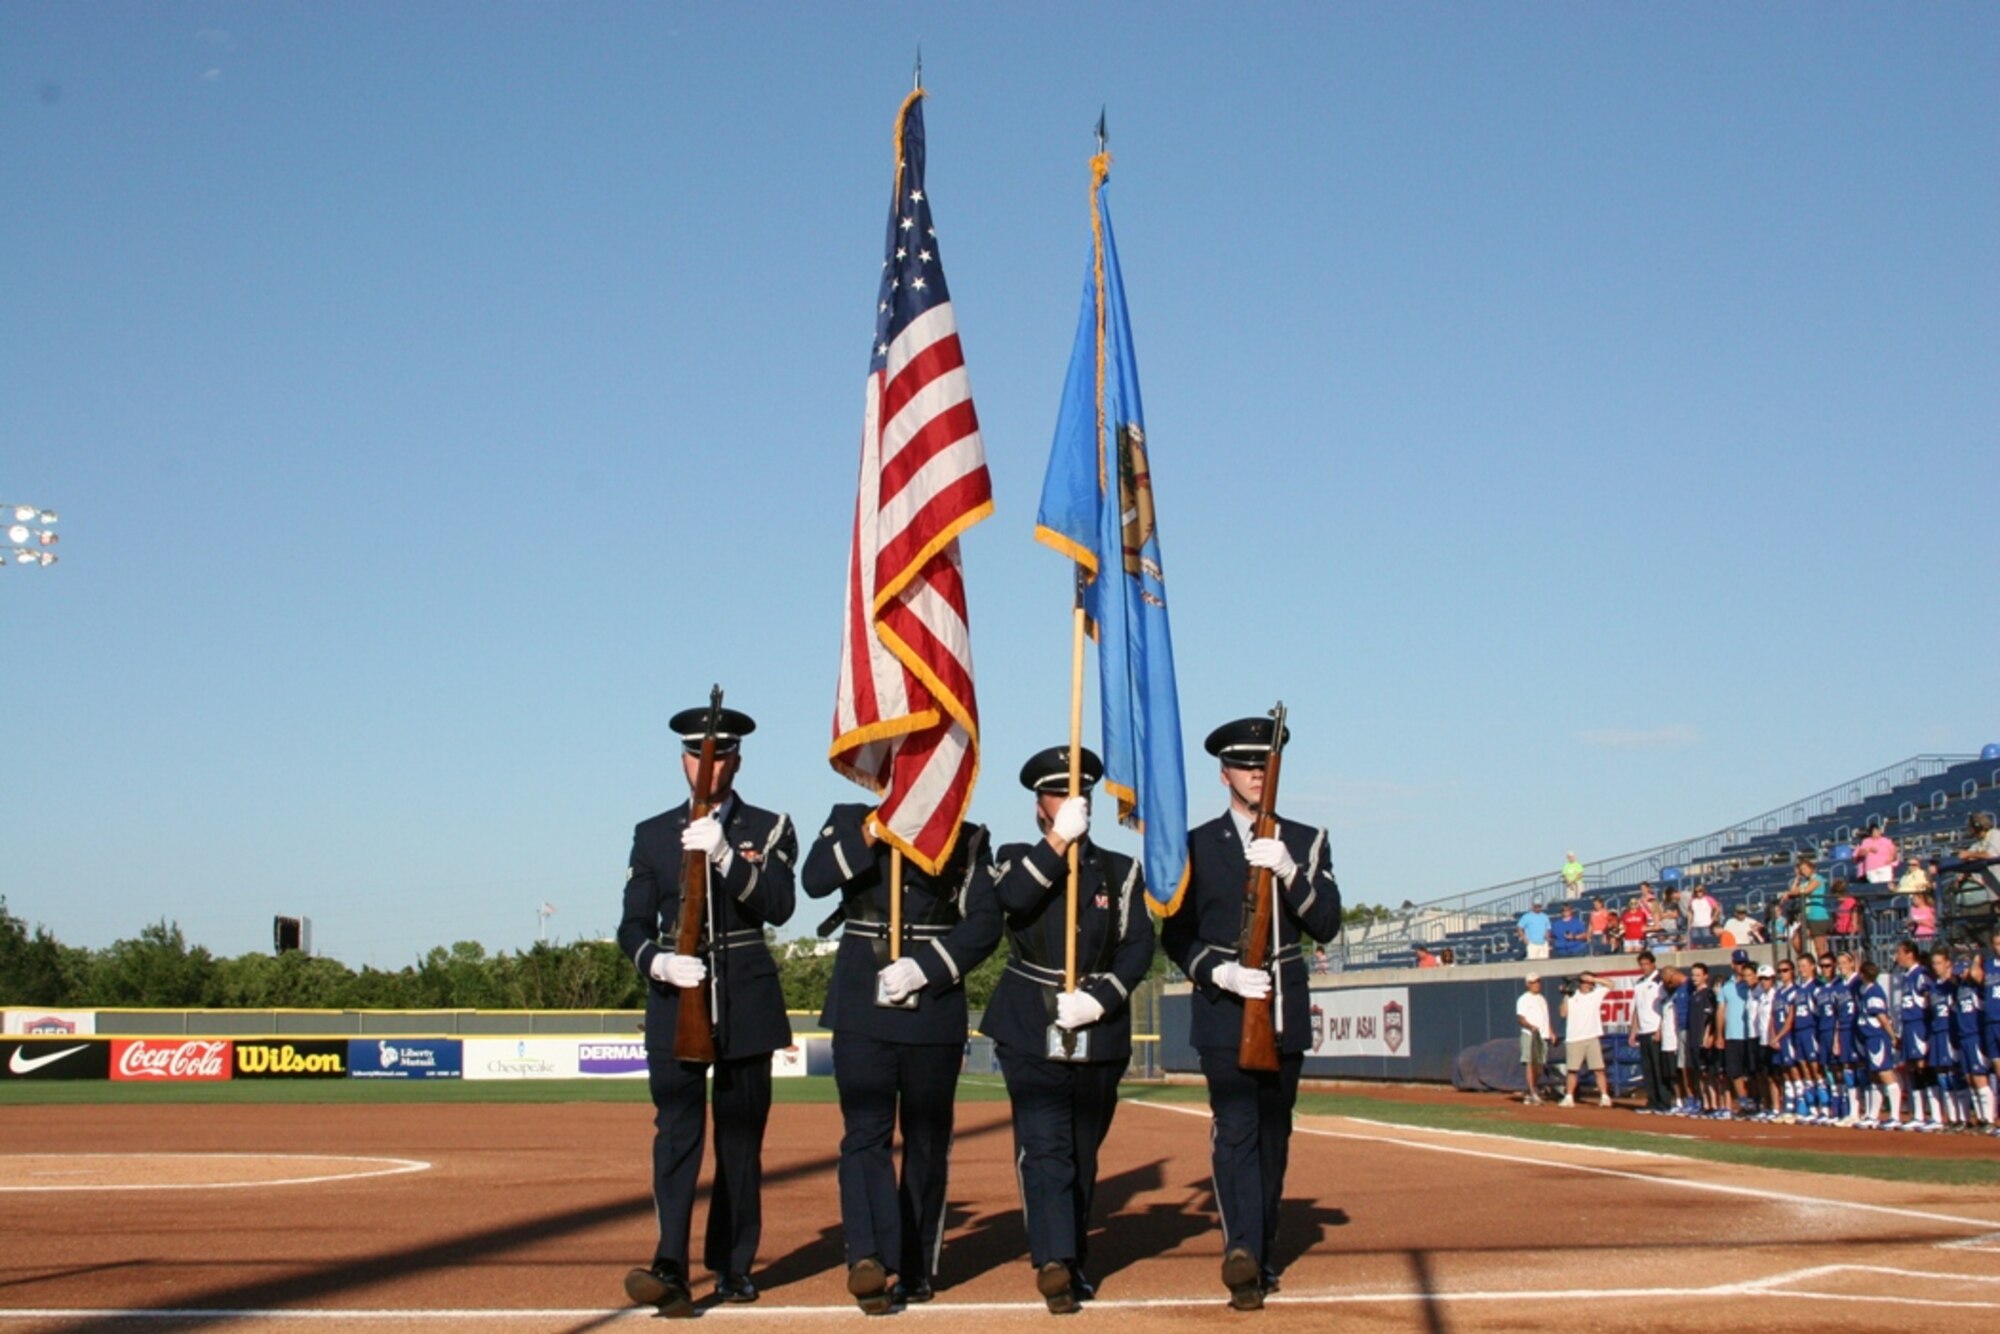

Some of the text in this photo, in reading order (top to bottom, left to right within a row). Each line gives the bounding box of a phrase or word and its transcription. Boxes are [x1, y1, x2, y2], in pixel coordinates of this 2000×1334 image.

[1936, 1004, 1949, 1017] 2
[1330, 1017, 1351, 1041] PLAY
[1356, 1016, 1377, 1039] ASA!
[119, 1040, 227, 1076] Coca-Cola
[236, 1045, 343, 1072] Wilson
[400, 1048, 434, 1058] Liberty
[400, 1057, 436, 1066] Mutual
[487, 1060, 555, 1076] Chesapeake
